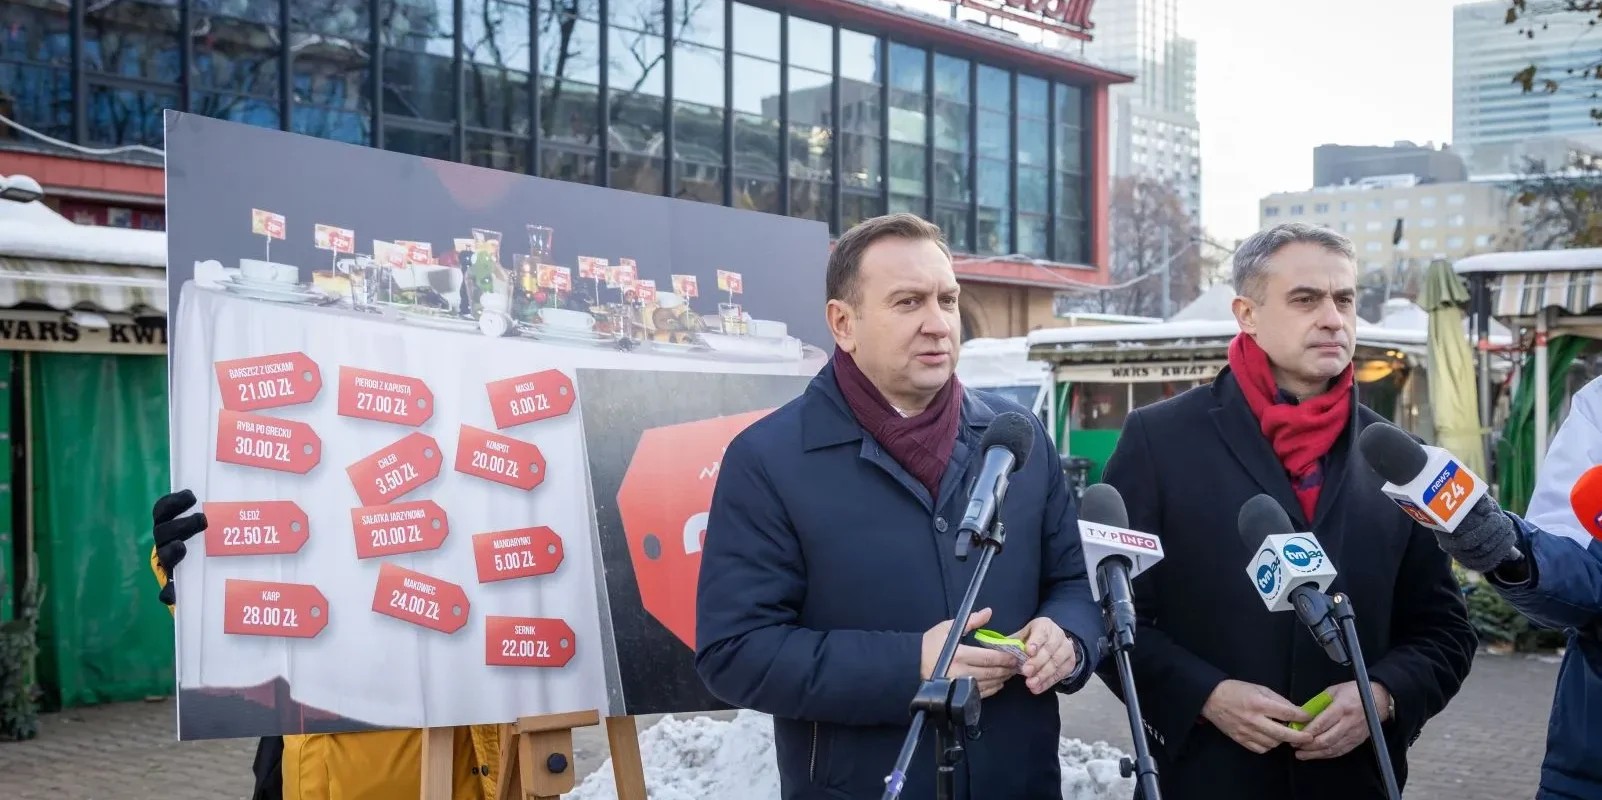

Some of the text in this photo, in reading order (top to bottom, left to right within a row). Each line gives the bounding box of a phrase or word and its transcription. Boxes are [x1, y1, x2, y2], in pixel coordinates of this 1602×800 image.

[0, 319, 79, 341] WARS
[229, 362, 294, 379] BARSZCZ Z USZKAMI
[1161, 365, 1207, 376] KWIAT
[239, 378, 295, 402] 21.00 ZŁ
[355, 376, 411, 397] PIEROGI Z KAPUSTĄ
[357, 392, 408, 416] 27.00 ZŁ
[510, 393, 551, 417] 8.00 ZŁ
[236, 420, 292, 439] RYBA PO GRECKU
[235, 436, 291, 462] 30.00 ZŁ
[486, 439, 511, 454] KOMPOT
[377, 453, 398, 470] CHLEB
[471, 450, 519, 479] 20.00 ZŁ
[375, 462, 419, 495] 3.50 ZŁ
[1431, 469, 1451, 492] news
[1440, 481, 1465, 511] 24
[239, 507, 261, 521] ŚLEDŹ
[361, 508, 426, 526] SAŁATKA JARZYNOWA
[223, 525, 280, 546] 22.50 ZŁ
[371, 524, 424, 548] 20.00 ZŁ
[493, 536, 532, 549] MANDARYNKI
[1087, 527, 1156, 549] TVP INFO
[494, 550, 537, 572] 5.00 ZŁ
[262, 590, 281, 602] KARP
[403, 577, 437, 596] MAKOWIEC
[390, 589, 441, 621] 24.00 ZŁ
[242, 605, 299, 627] 28.00 ZŁ
[514, 624, 536, 636] SERNIK
[502, 639, 551, 658] 22.00 ZŁ
